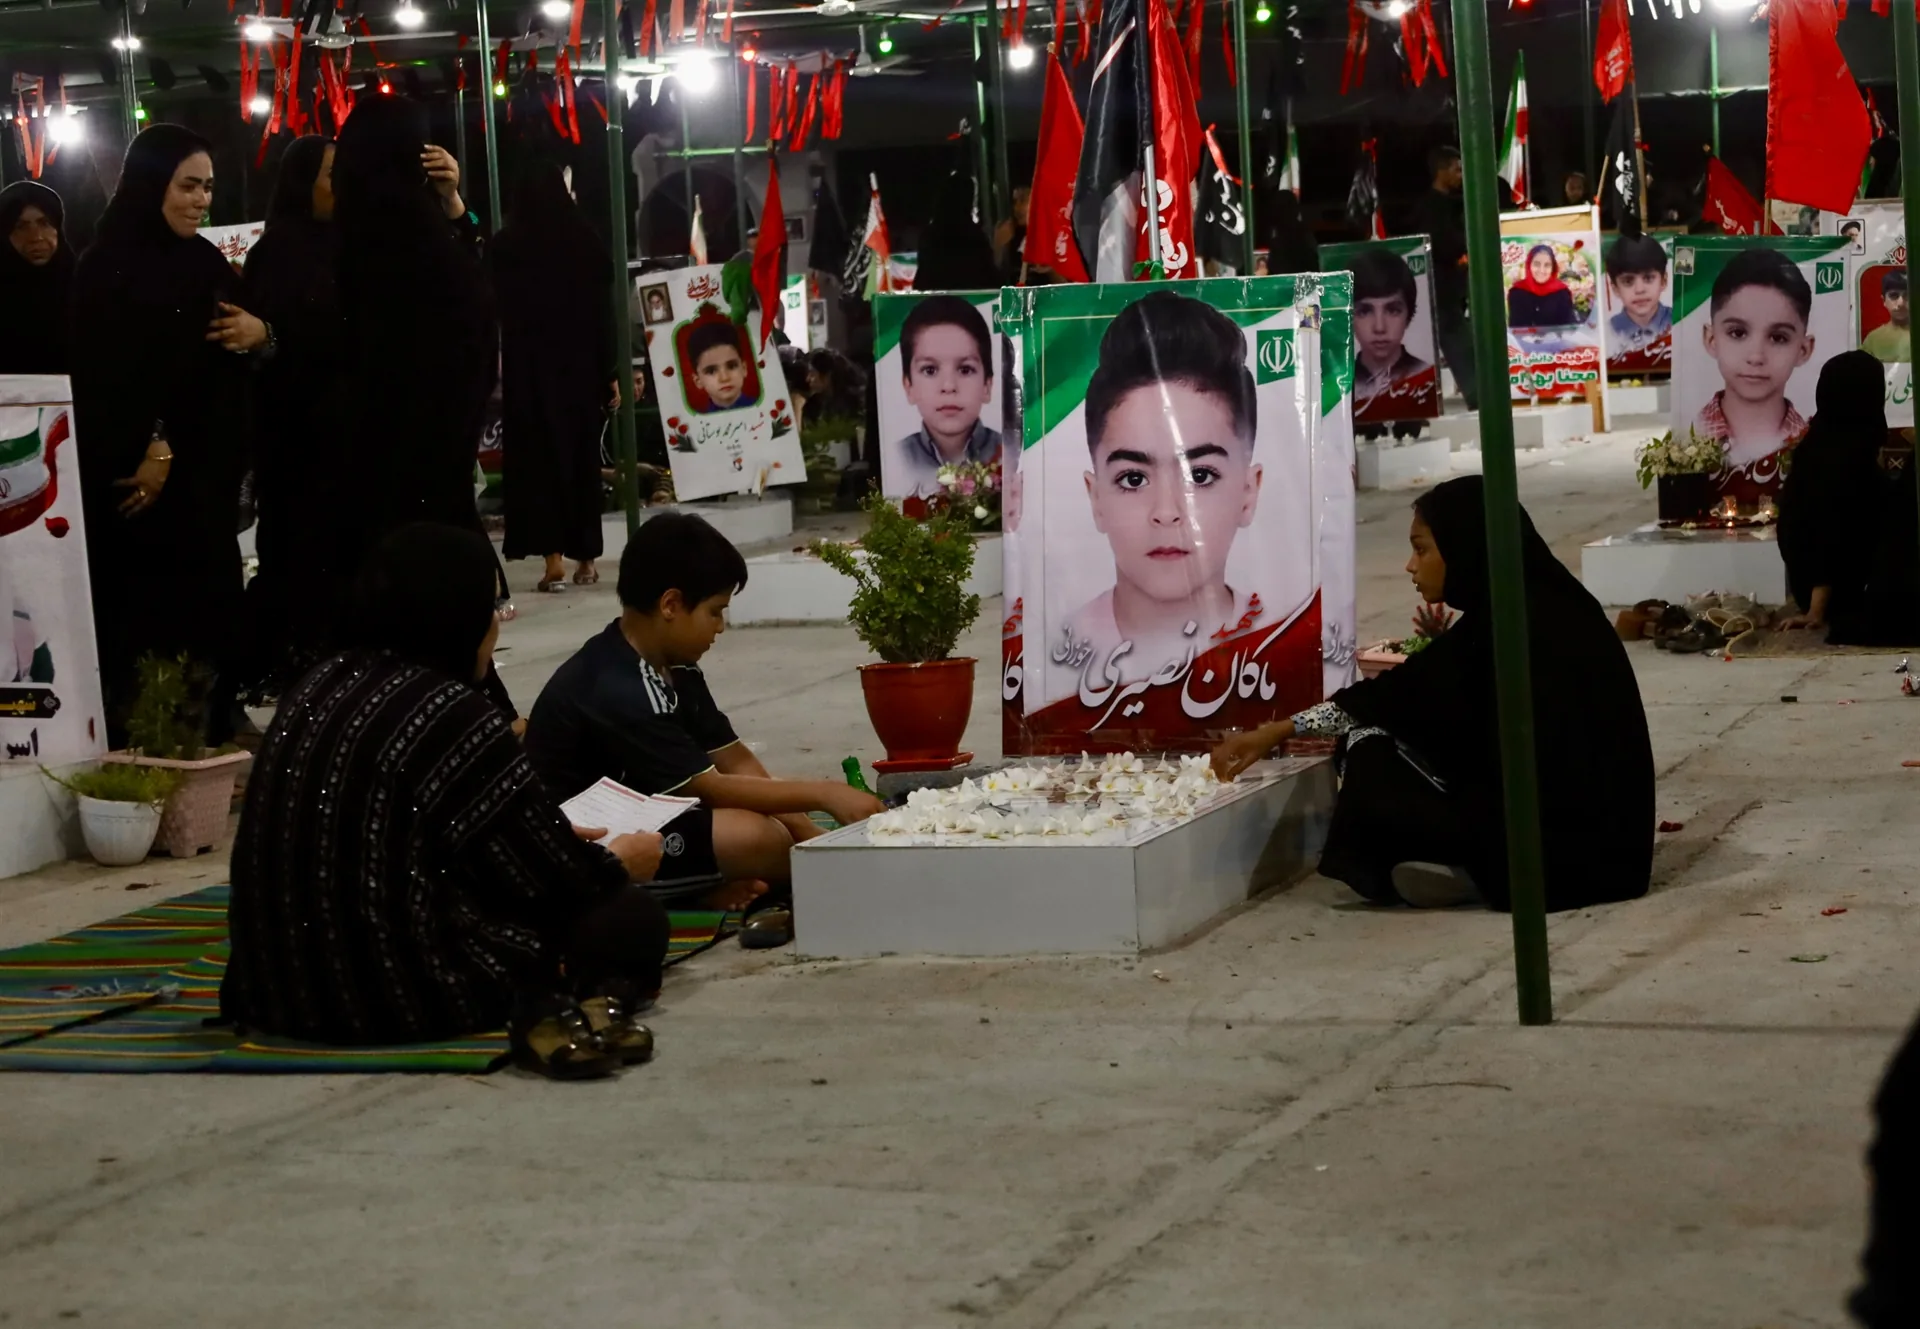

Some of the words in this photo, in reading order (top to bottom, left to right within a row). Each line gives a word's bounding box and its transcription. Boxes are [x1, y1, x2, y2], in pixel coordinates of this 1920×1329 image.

[1180, 585, 1321, 719] ماکان
[1211, 592, 1263, 639] شهید
[1078, 620, 1202, 734] نصیری
